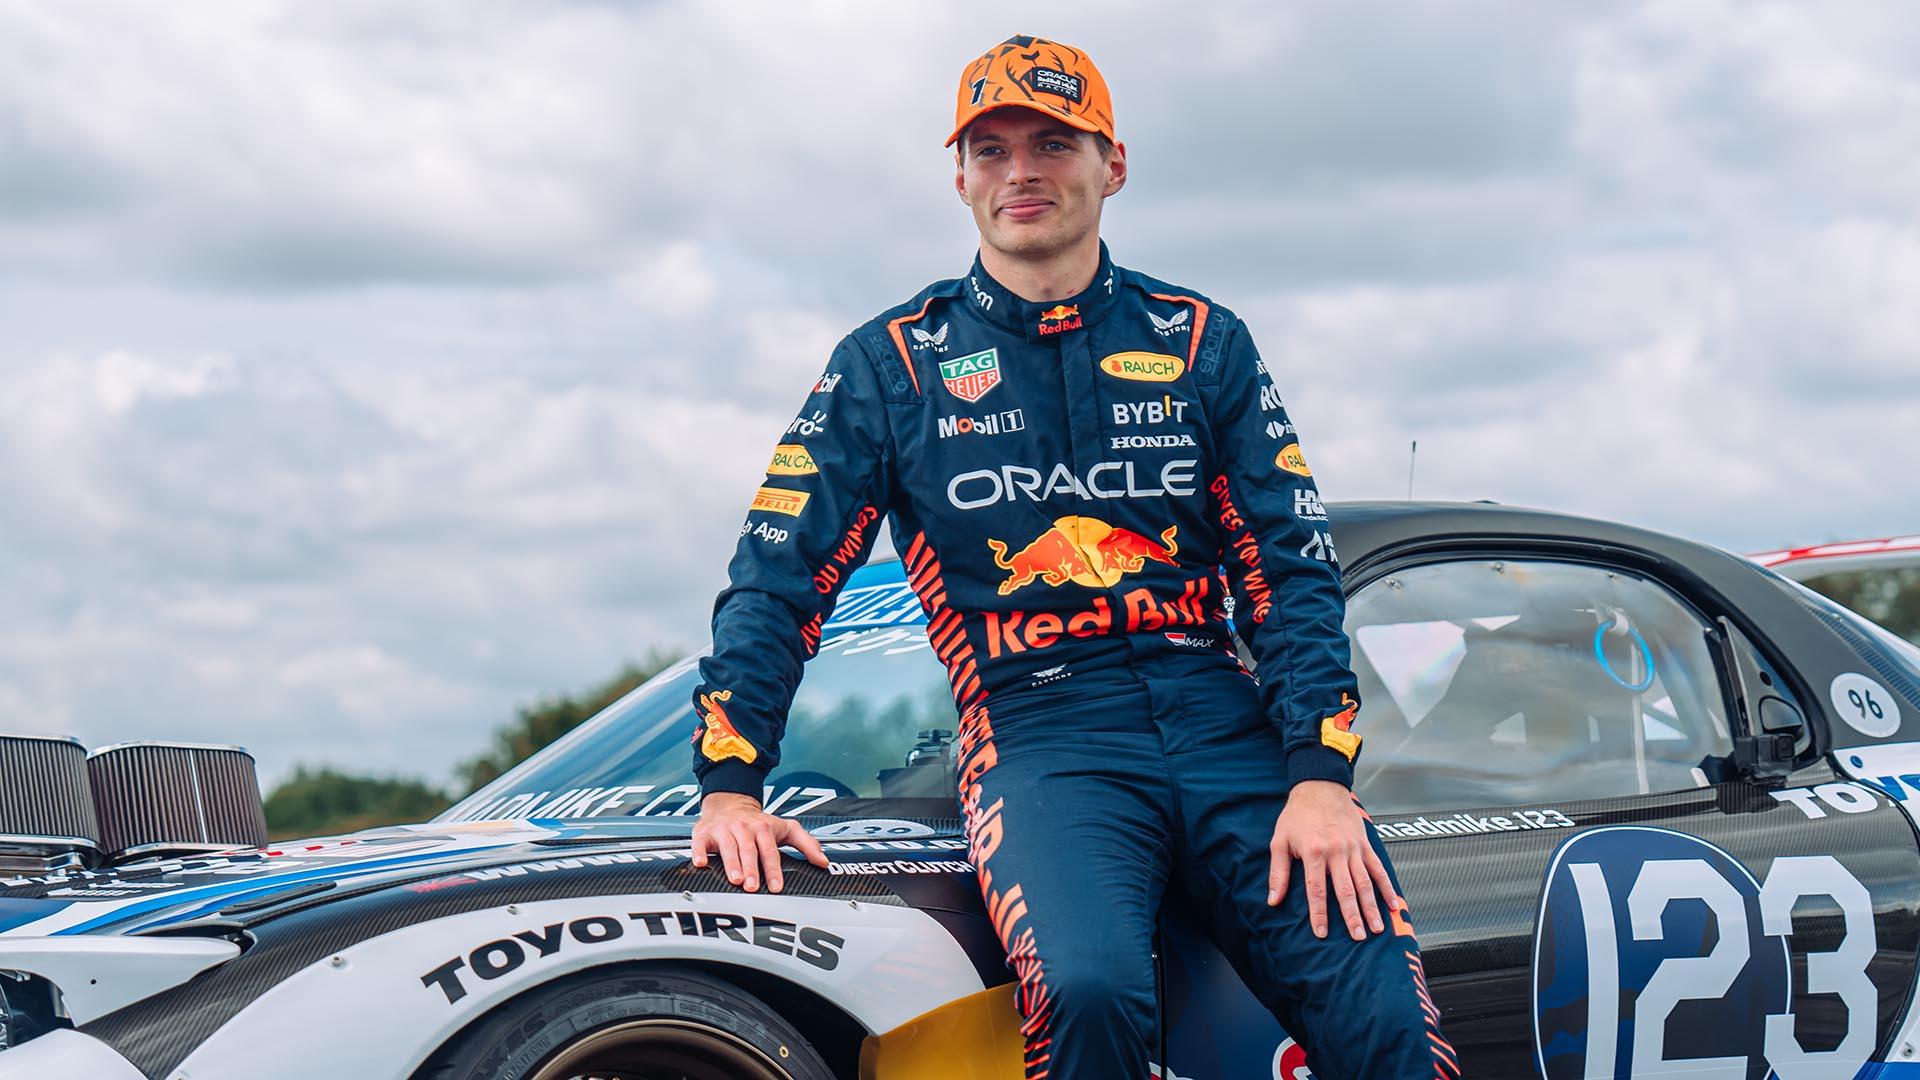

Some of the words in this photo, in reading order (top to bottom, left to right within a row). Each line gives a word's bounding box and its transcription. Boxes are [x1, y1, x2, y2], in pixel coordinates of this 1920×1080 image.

[971, 75, 987, 105] 1
[1037, 70, 1078, 86] ORACLE
[1038, 320, 1062, 336] Red
[1063, 315, 1083, 332] Bull
[943, 354, 993, 378] TAG
[1123, 361, 1175, 375] RAUCH
[944, 371, 997, 399] HEUER
[1112, 395, 1188, 424] BYBIT
[937, 413, 999, 438] Mobil
[1110, 433, 1196, 449] HONDA
[771, 453, 815, 470] RAUCH
[947, 459, 1198, 510] ORACLE
[753, 498, 798, 511] RELLI
[1210, 474, 1244, 532] GIVES
[753, 521, 788, 544] App
[982, 597, 1113, 659] Red
[1185, 637, 1215, 648] MAX
[1847, 688, 1884, 719] 96
[420, 916, 624, 1005] TOYO
[628, 910, 846, 972] TIRES
[1567, 855, 1879, 1080] 123
